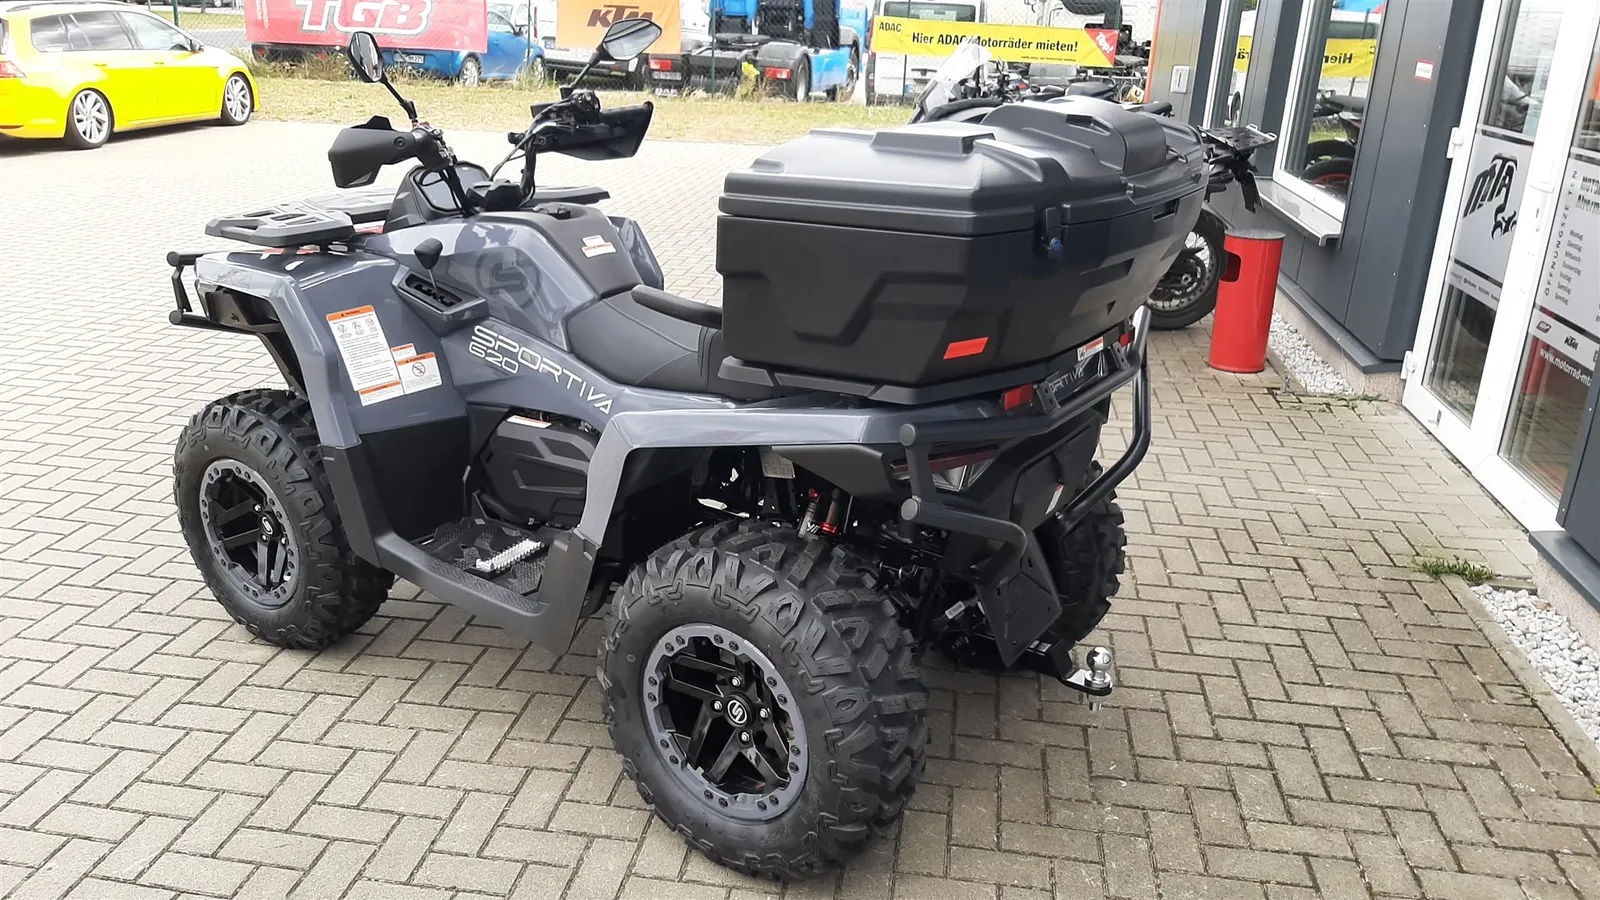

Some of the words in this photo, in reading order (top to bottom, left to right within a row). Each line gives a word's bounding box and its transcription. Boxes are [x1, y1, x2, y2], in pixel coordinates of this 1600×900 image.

[296, 0, 432, 34] TGB
[879, 21, 902, 32] ADAC
[912, 32, 934, 44] Hier
[937, 34, 967, 45] ADAC
[1036, 40, 1078, 52] mieten!
[1580, 176, 1600, 195] MOTO
[1564, 335, 1579, 350] KTM
[469, 341, 519, 374] 620
[472, 325, 614, 415] SPORTIVA
[1049, 367, 1085, 393] ORTIVA
